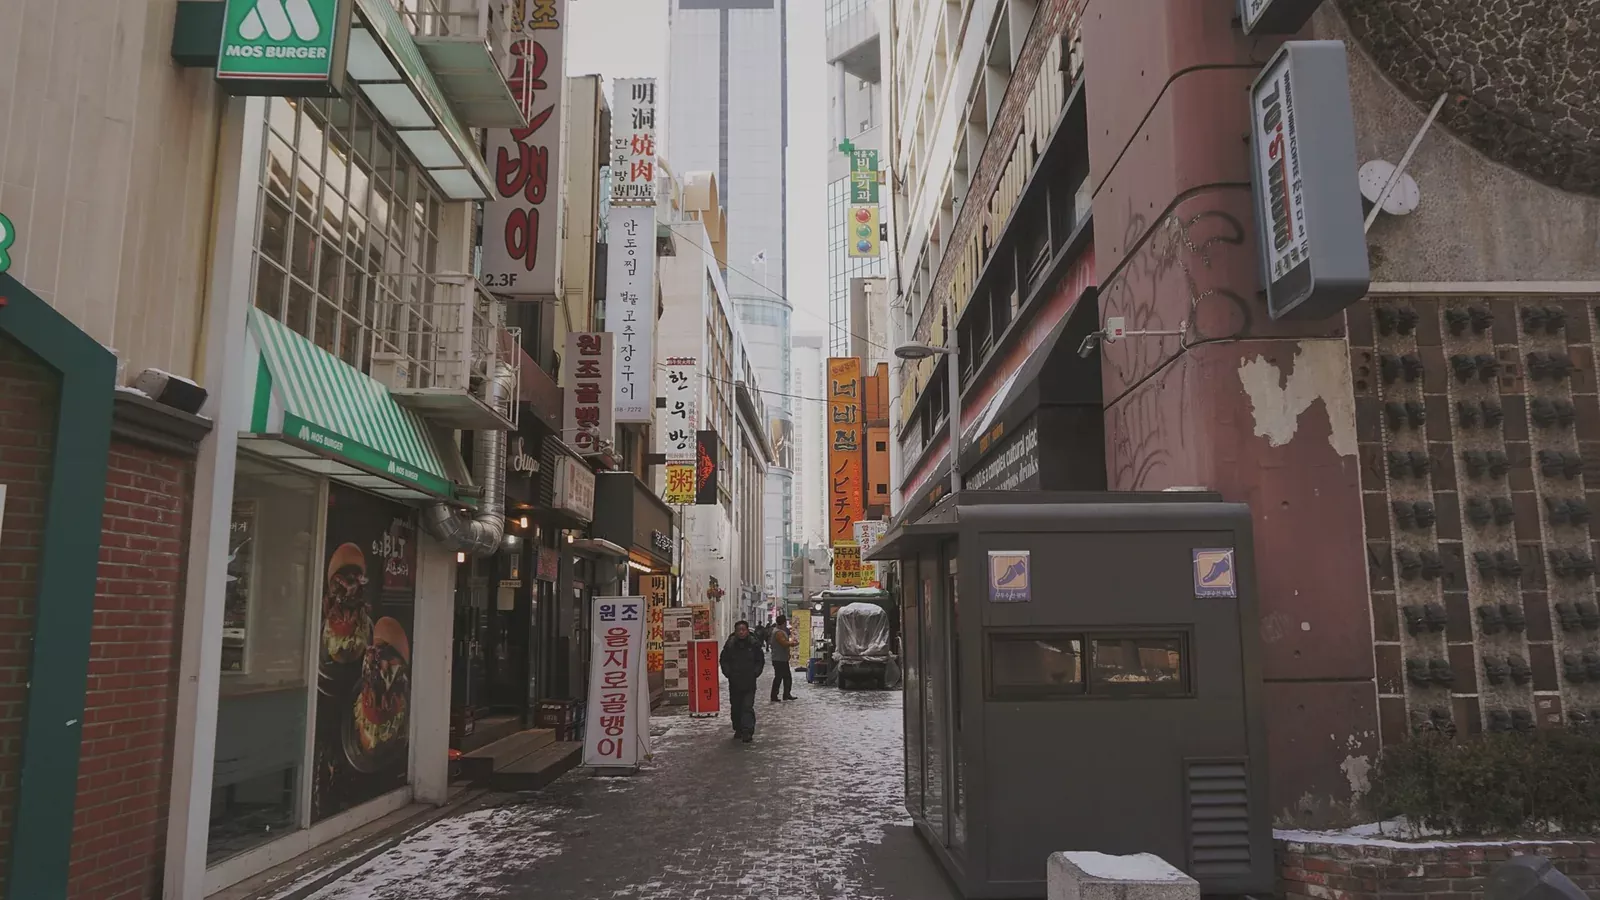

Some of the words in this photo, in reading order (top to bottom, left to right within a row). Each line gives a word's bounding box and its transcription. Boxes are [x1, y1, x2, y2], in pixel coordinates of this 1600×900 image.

[225, 45, 263, 58] MOS
[265, 46, 327, 60] BURGER
[614, 138, 628, 182] 한우방
[485, 273, 517, 287] 2.3F
[668, 370, 689, 450] 한우방
[311, 431, 323, 444] MOS
[324, 436, 344, 452] BURGER
[597, 627, 631, 759] 을지로골뱅이
